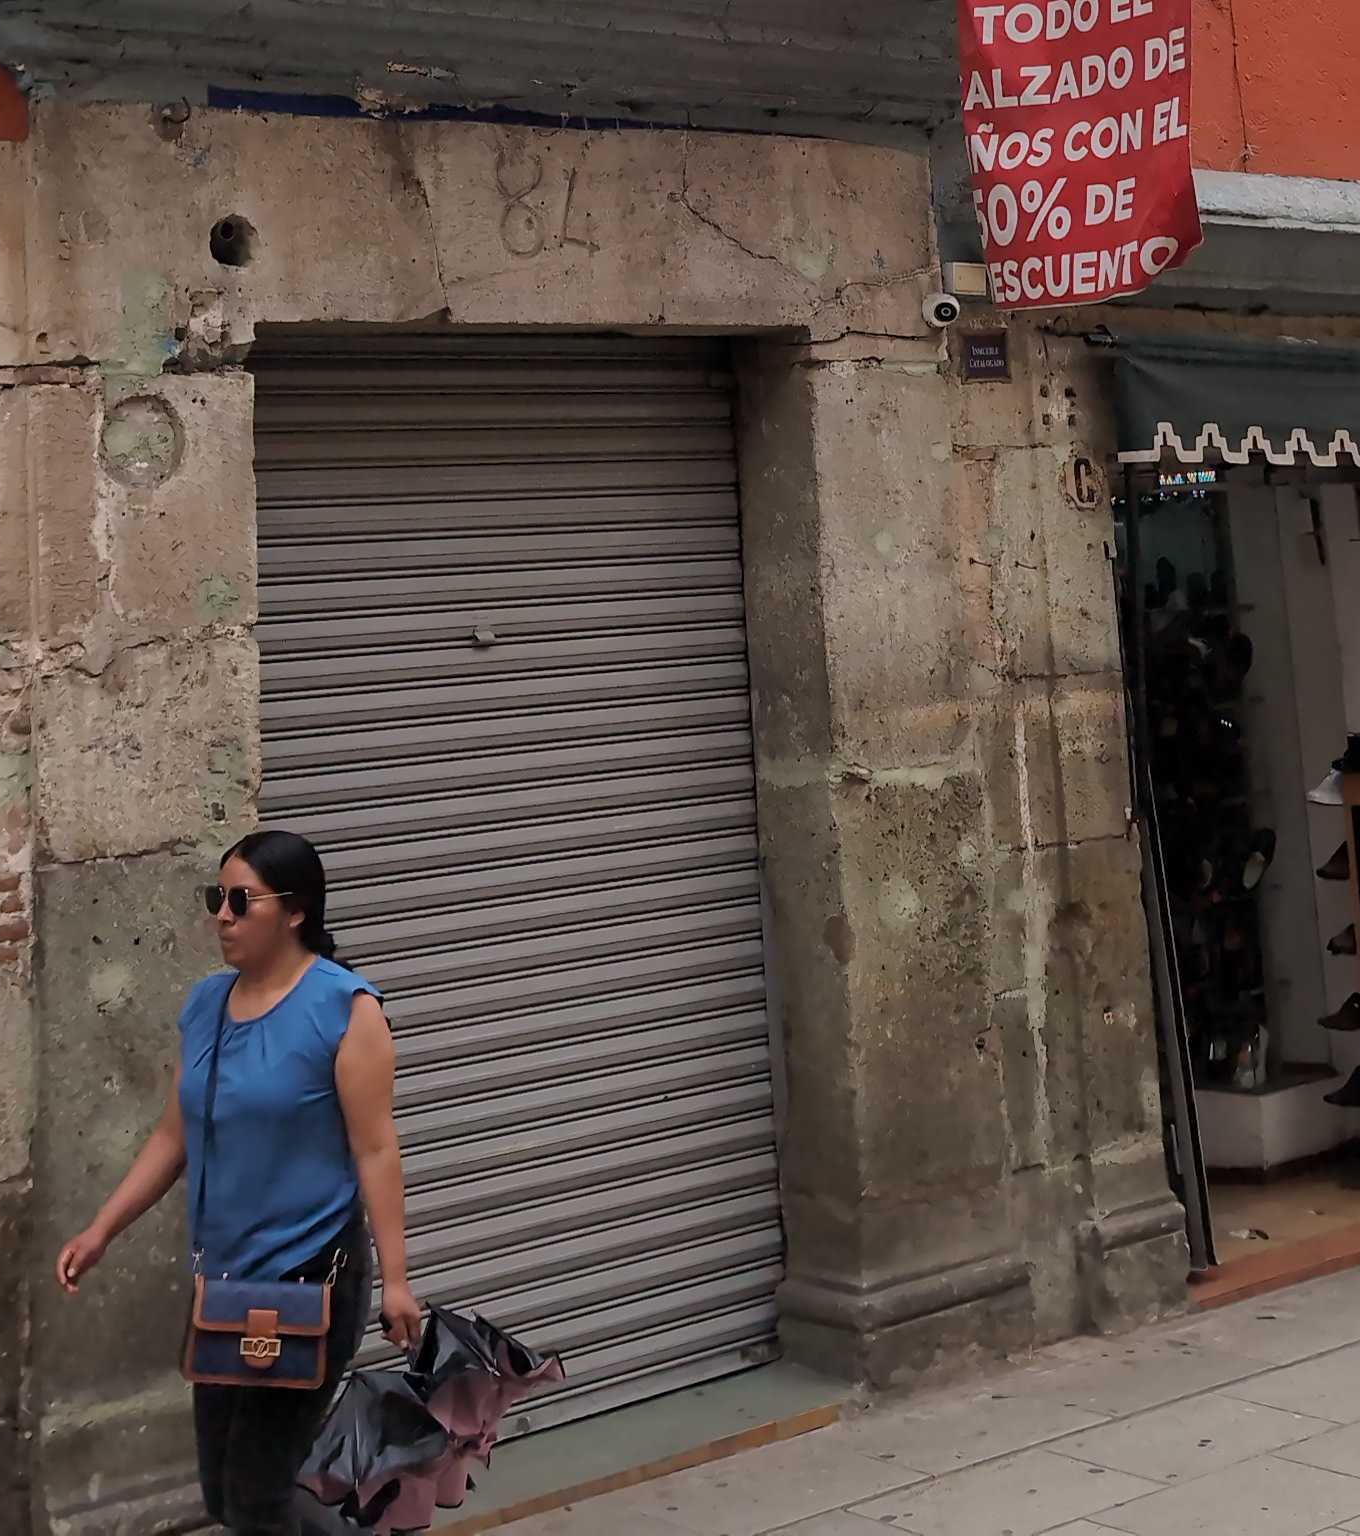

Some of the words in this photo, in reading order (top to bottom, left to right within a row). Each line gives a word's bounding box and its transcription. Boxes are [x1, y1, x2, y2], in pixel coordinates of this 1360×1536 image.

[959, 46, 1134, 111] ALZADO
[1144, 26, 1186, 81] DE
[1063, 108, 1143, 162] CON
[1152, 96, 1188, 146] EL
[1085, 177, 1136, 226] DE
[987, 236, 1179, 304] ESCUENTO
